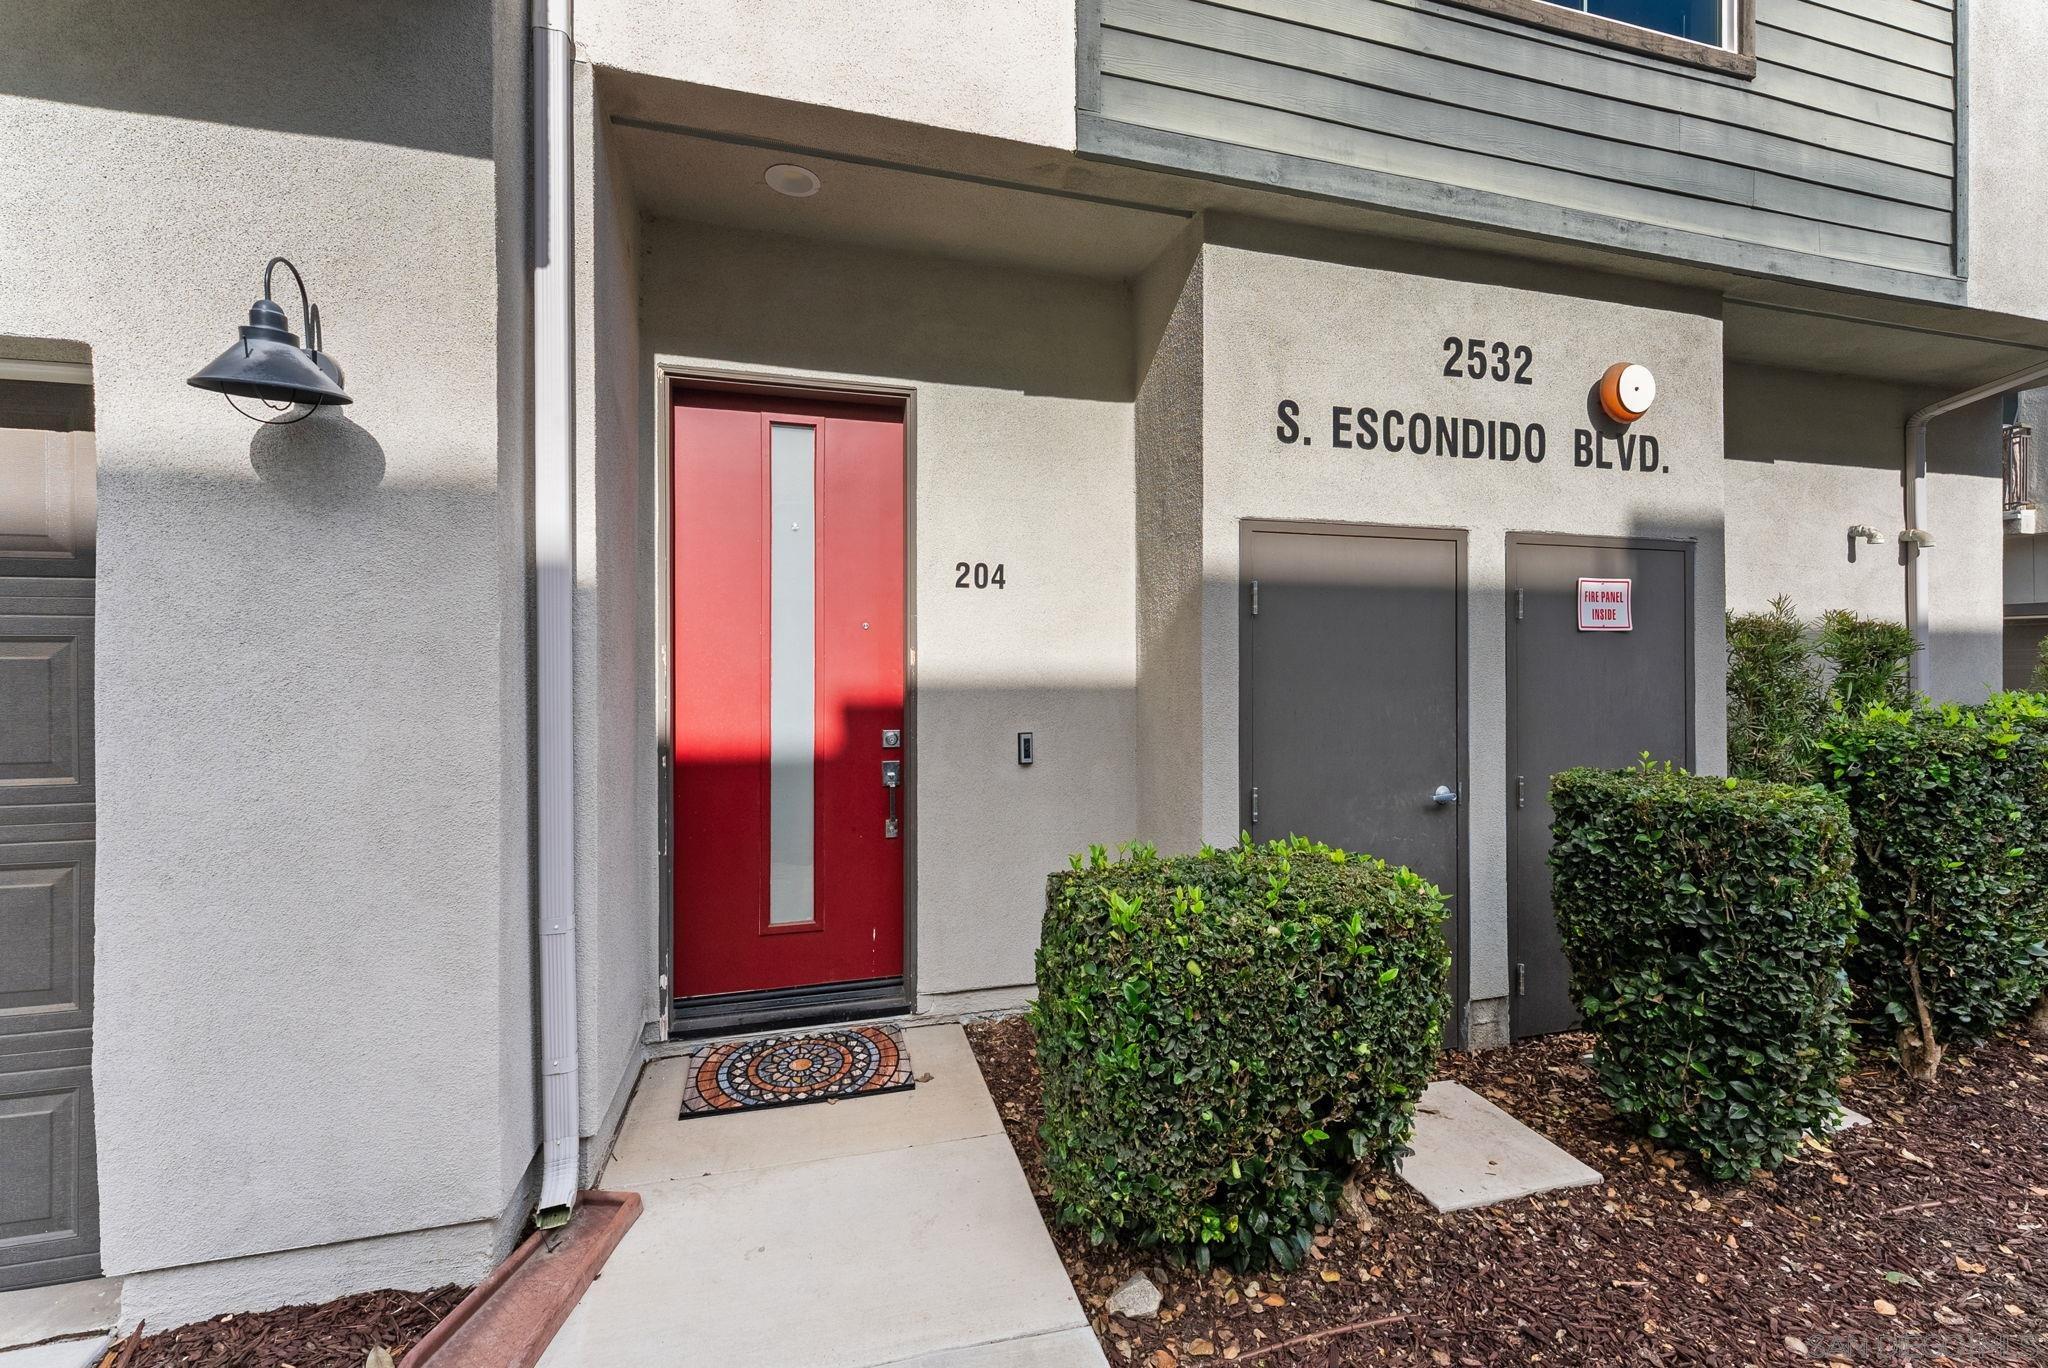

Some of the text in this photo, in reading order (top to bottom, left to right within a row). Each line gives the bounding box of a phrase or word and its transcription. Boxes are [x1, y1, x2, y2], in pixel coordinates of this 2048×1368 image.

[1443, 336, 1533, 385] 2532
[1276, 399, 1669, 474] S. ESCONDIDO BLVD.
[955, 561, 1006, 590] 204
[1584, 590, 1624, 603] FIRE PANEL
[1592, 608, 1616, 621] INSIDE
